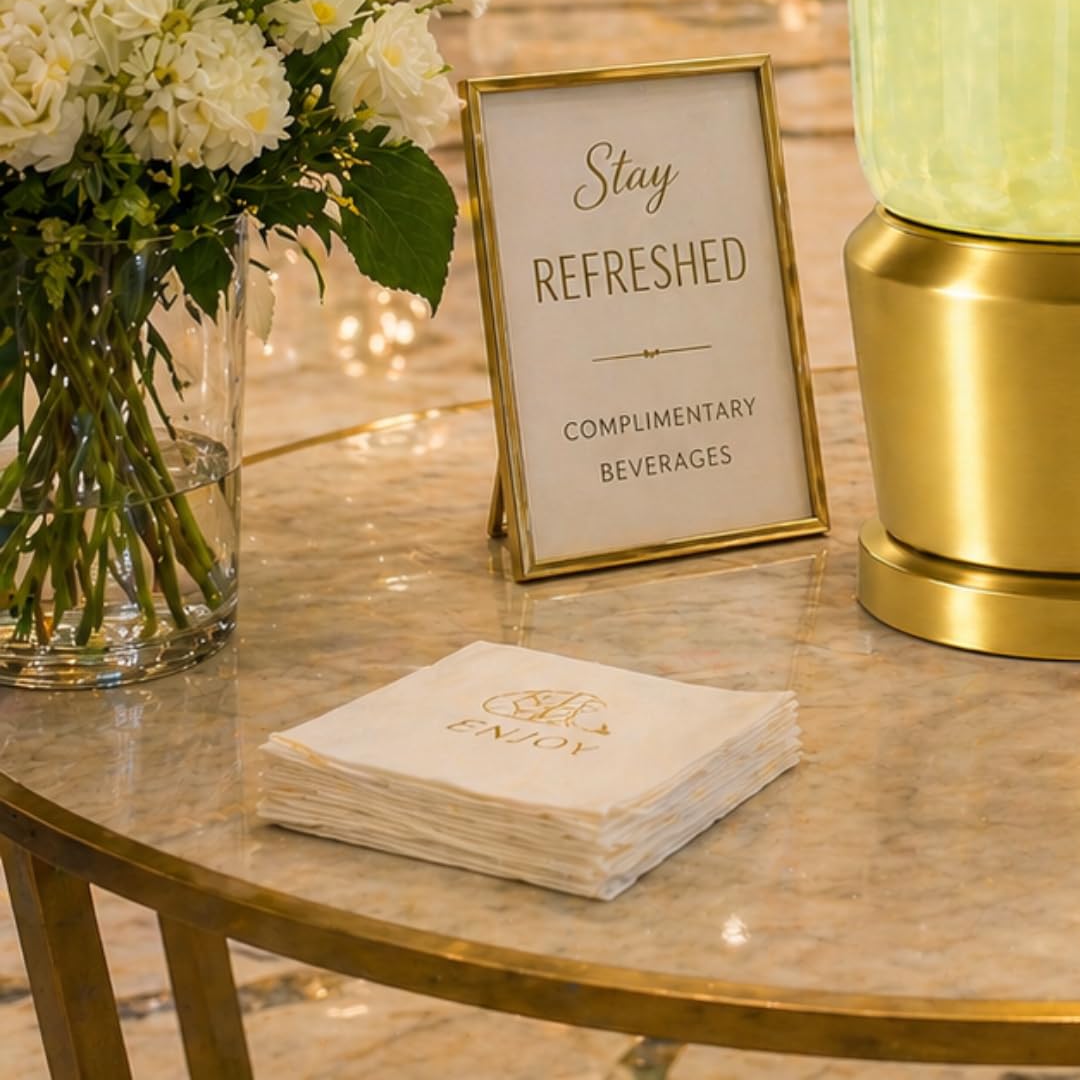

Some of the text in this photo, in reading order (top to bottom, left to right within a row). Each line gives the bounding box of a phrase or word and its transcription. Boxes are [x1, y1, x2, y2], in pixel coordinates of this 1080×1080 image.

[572, 140, 680, 215] Stay
[532, 236, 747, 303] REFRESHED
[563, 396, 756, 442] COMPLIMENTARY
[599, 445, 733, 484] BEVERAGES
[446, 719, 601, 756] ENJOY
